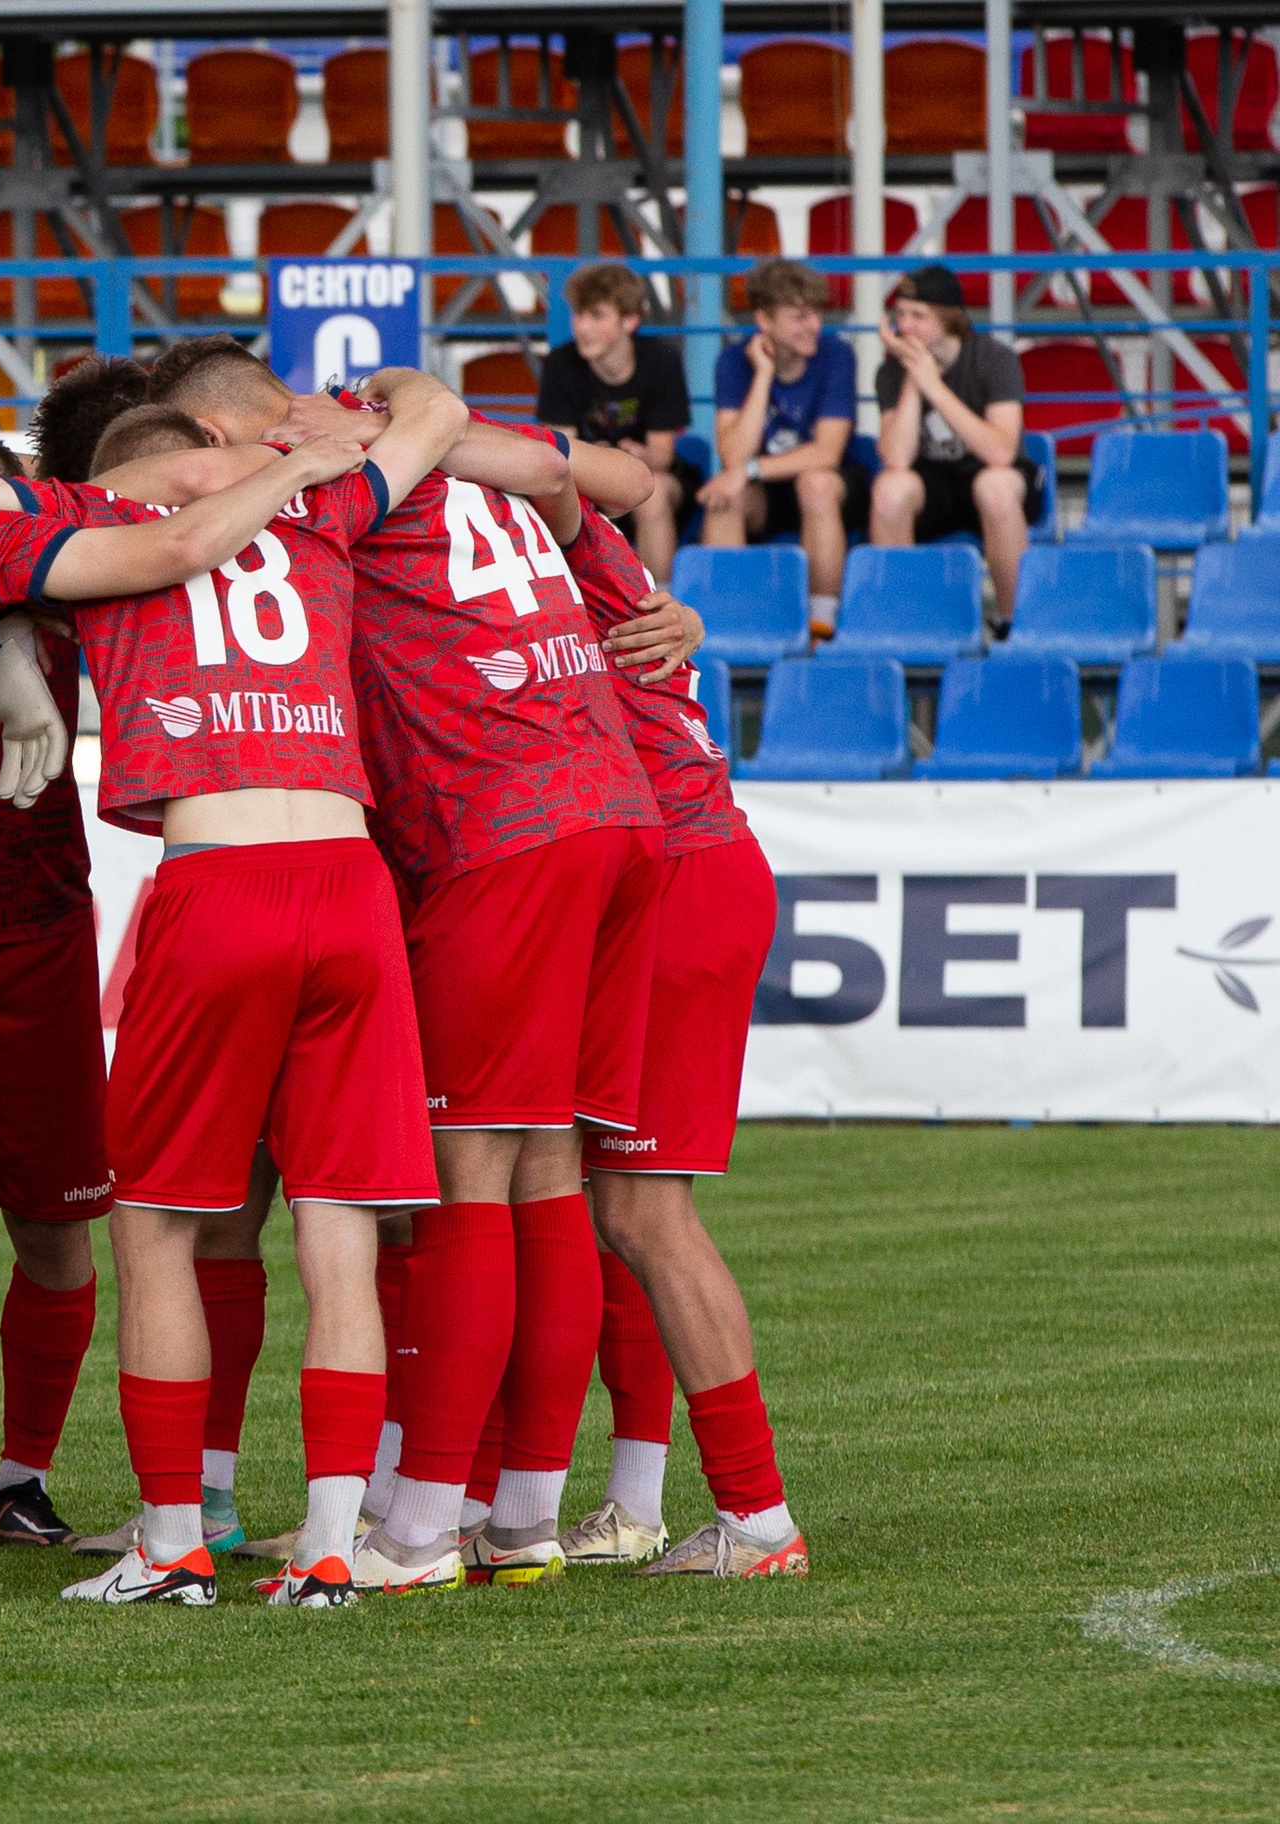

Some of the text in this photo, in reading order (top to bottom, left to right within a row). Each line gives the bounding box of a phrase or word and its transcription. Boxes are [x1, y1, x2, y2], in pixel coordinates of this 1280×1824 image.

[279, 264, 415, 308] СЕКТОР
[444, 478, 583, 617] 44
[183, 530, 310, 666] 18
[210, 693, 347, 738] МТБанк
[599, 1136, 658, 1154] uhlsport
[64, 1182, 113, 1202] uhlspor
